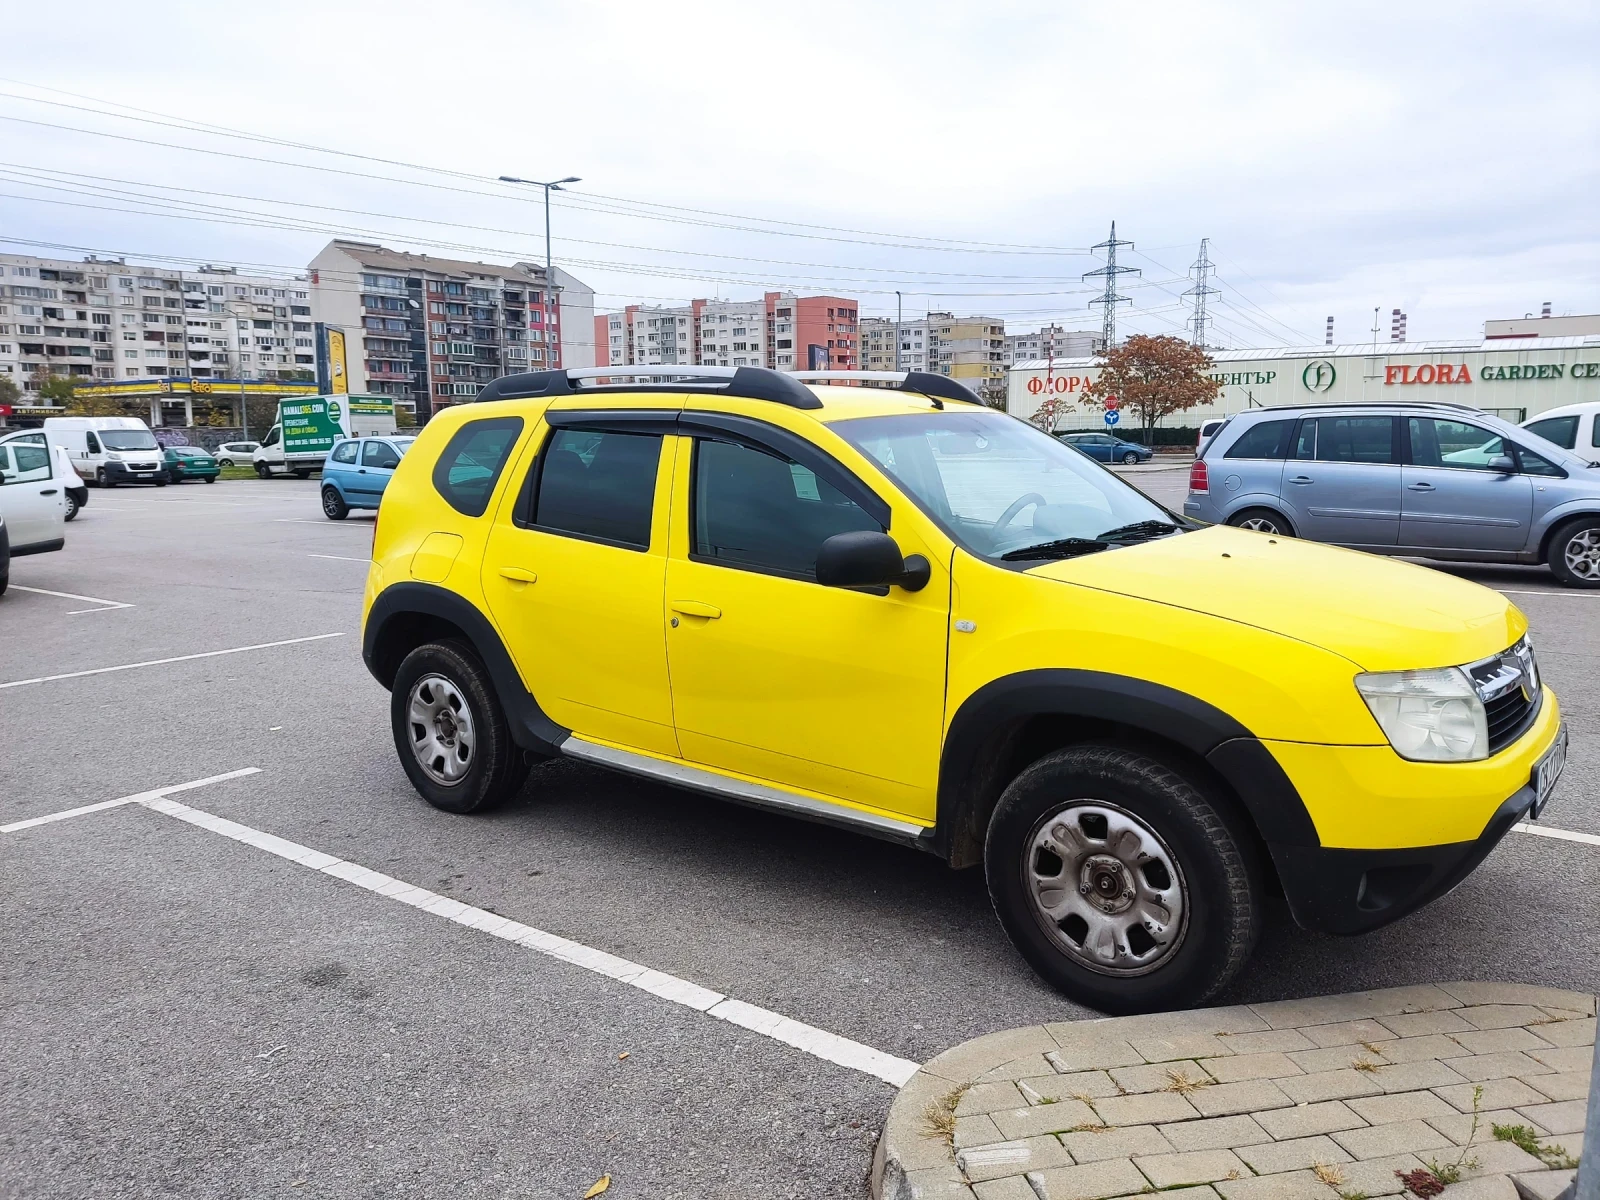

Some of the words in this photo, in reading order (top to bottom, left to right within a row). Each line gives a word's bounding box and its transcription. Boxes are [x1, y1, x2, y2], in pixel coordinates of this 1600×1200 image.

[1384, 363, 1472, 385] FLORA
[1480, 363, 1566, 380] GARDEN
[1570, 363, 1600, 379] CE
